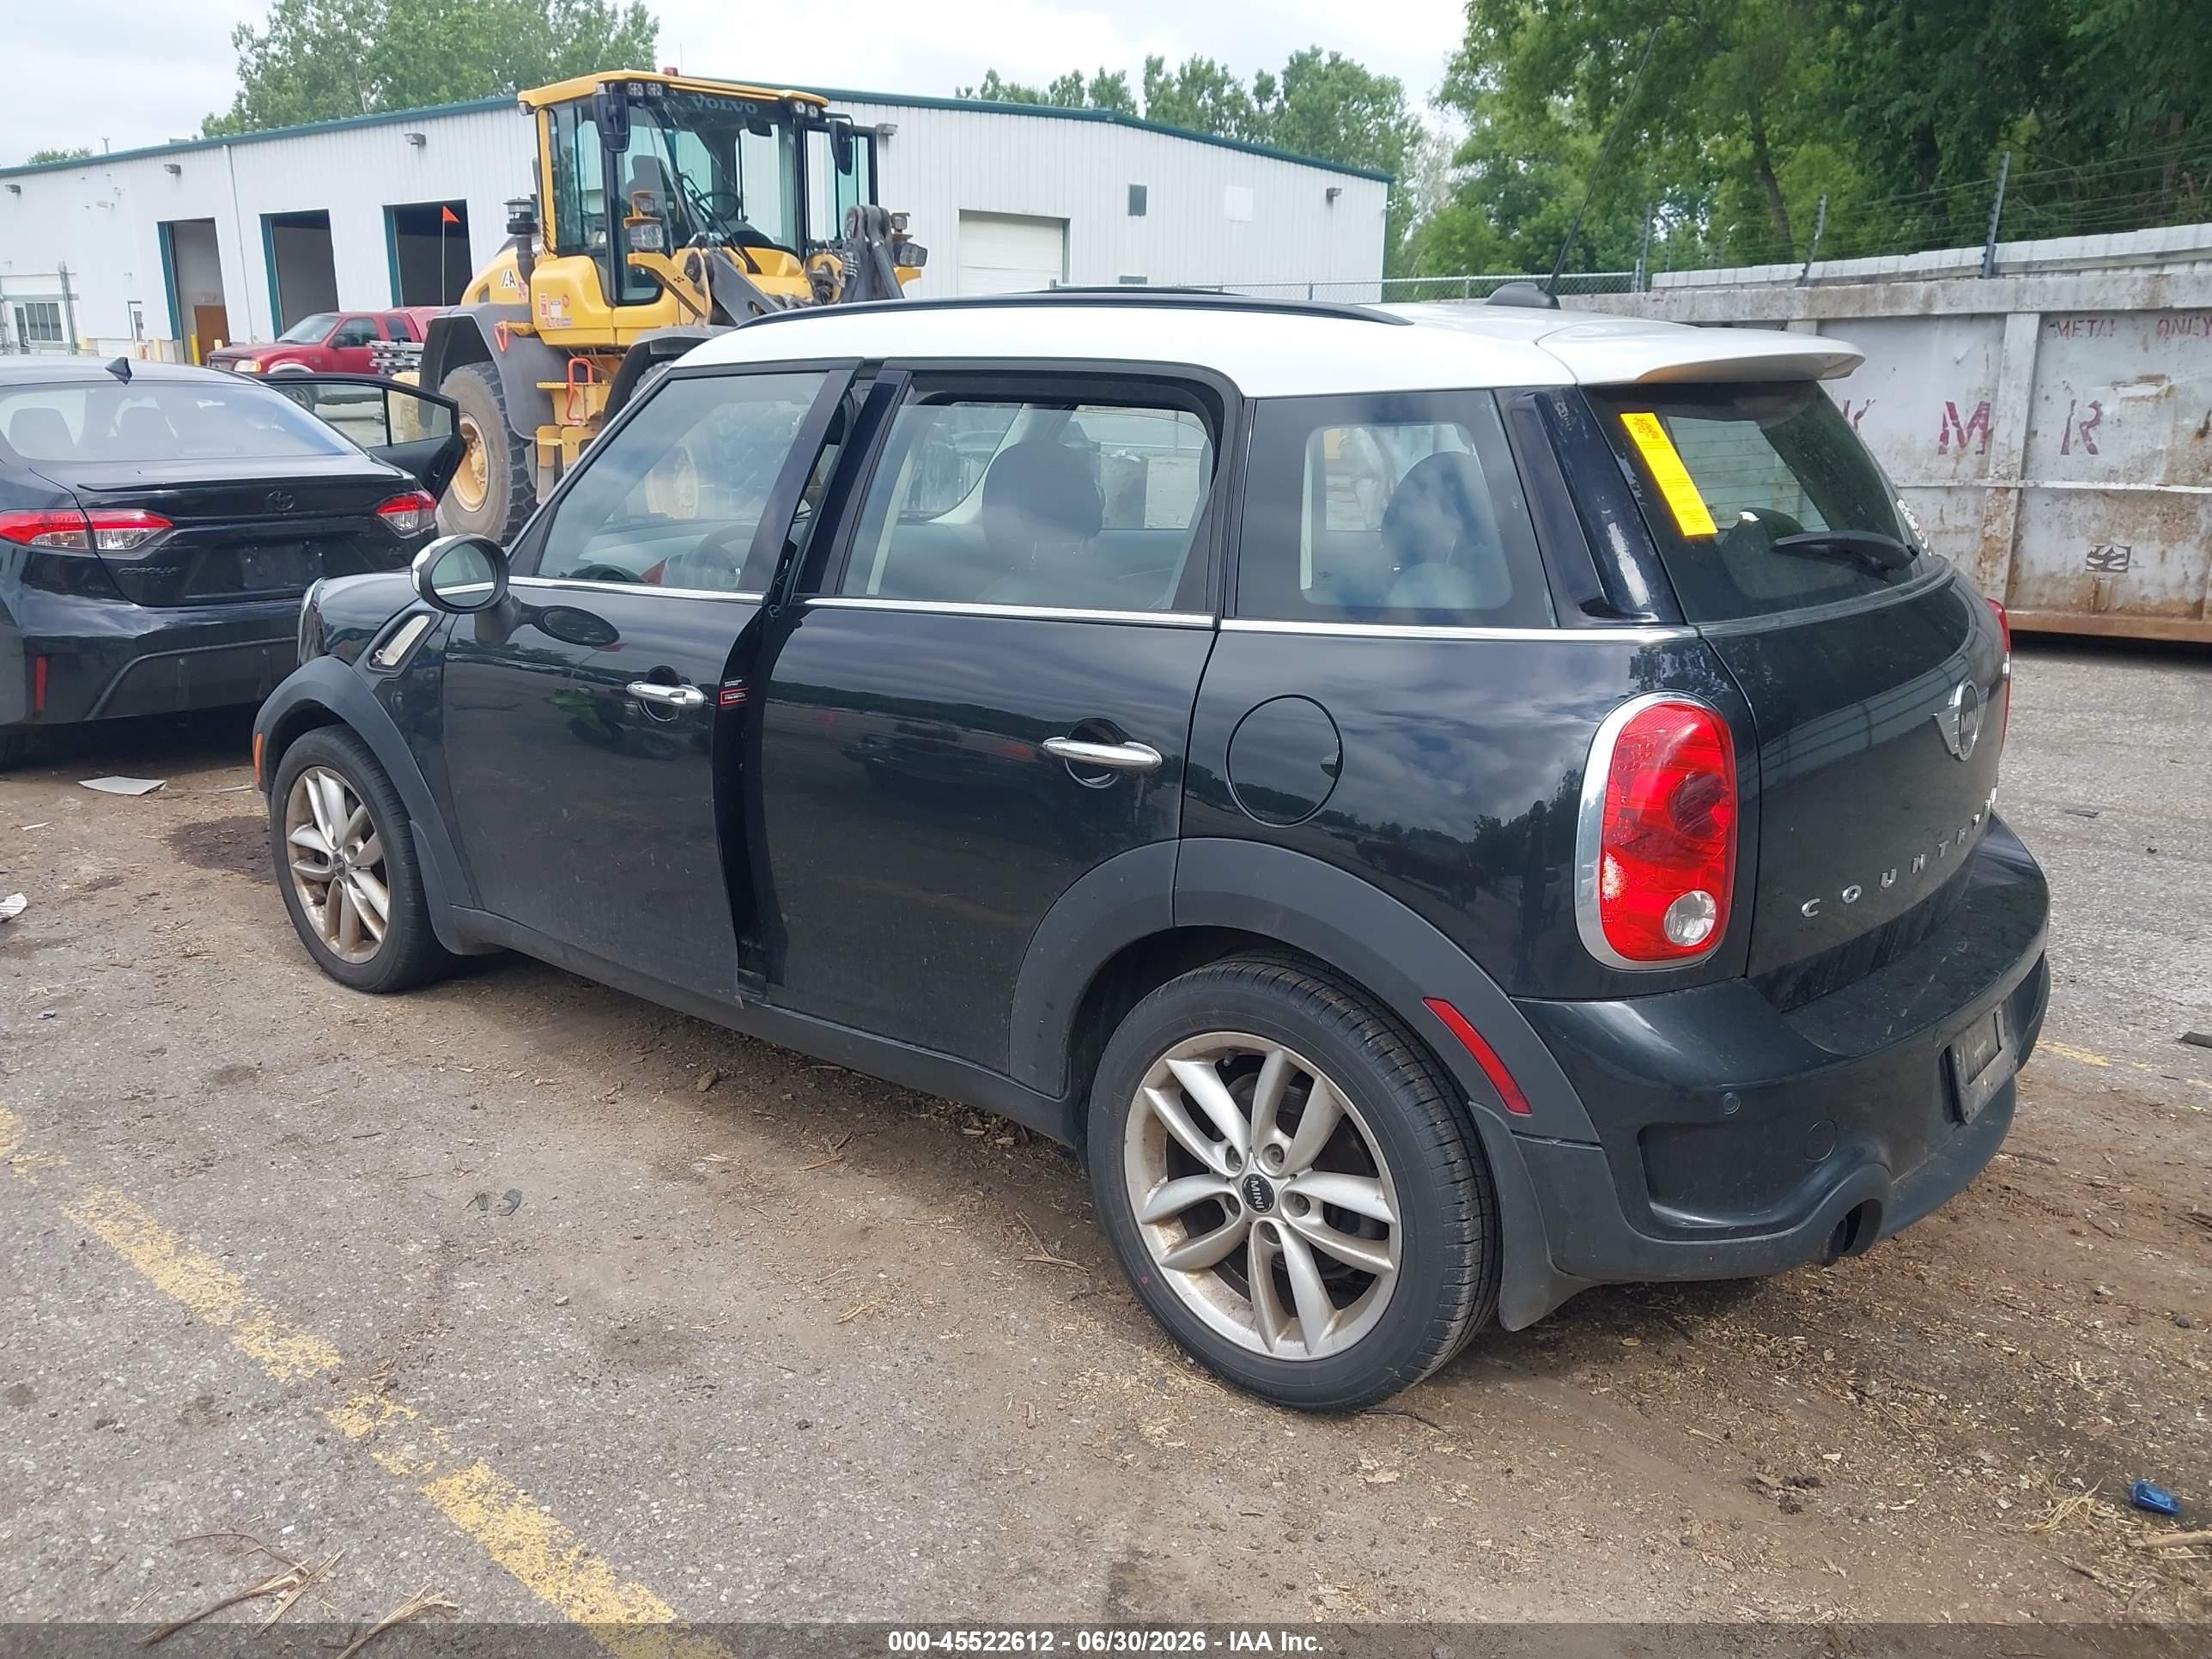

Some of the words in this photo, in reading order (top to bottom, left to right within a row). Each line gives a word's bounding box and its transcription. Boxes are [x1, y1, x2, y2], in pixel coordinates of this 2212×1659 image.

[688, 93, 757, 114] VOLVO
[1938, 400, 1991, 456] M
[2060, 398, 2103, 456] R
[1250, 1180, 1265, 1209] MINI
